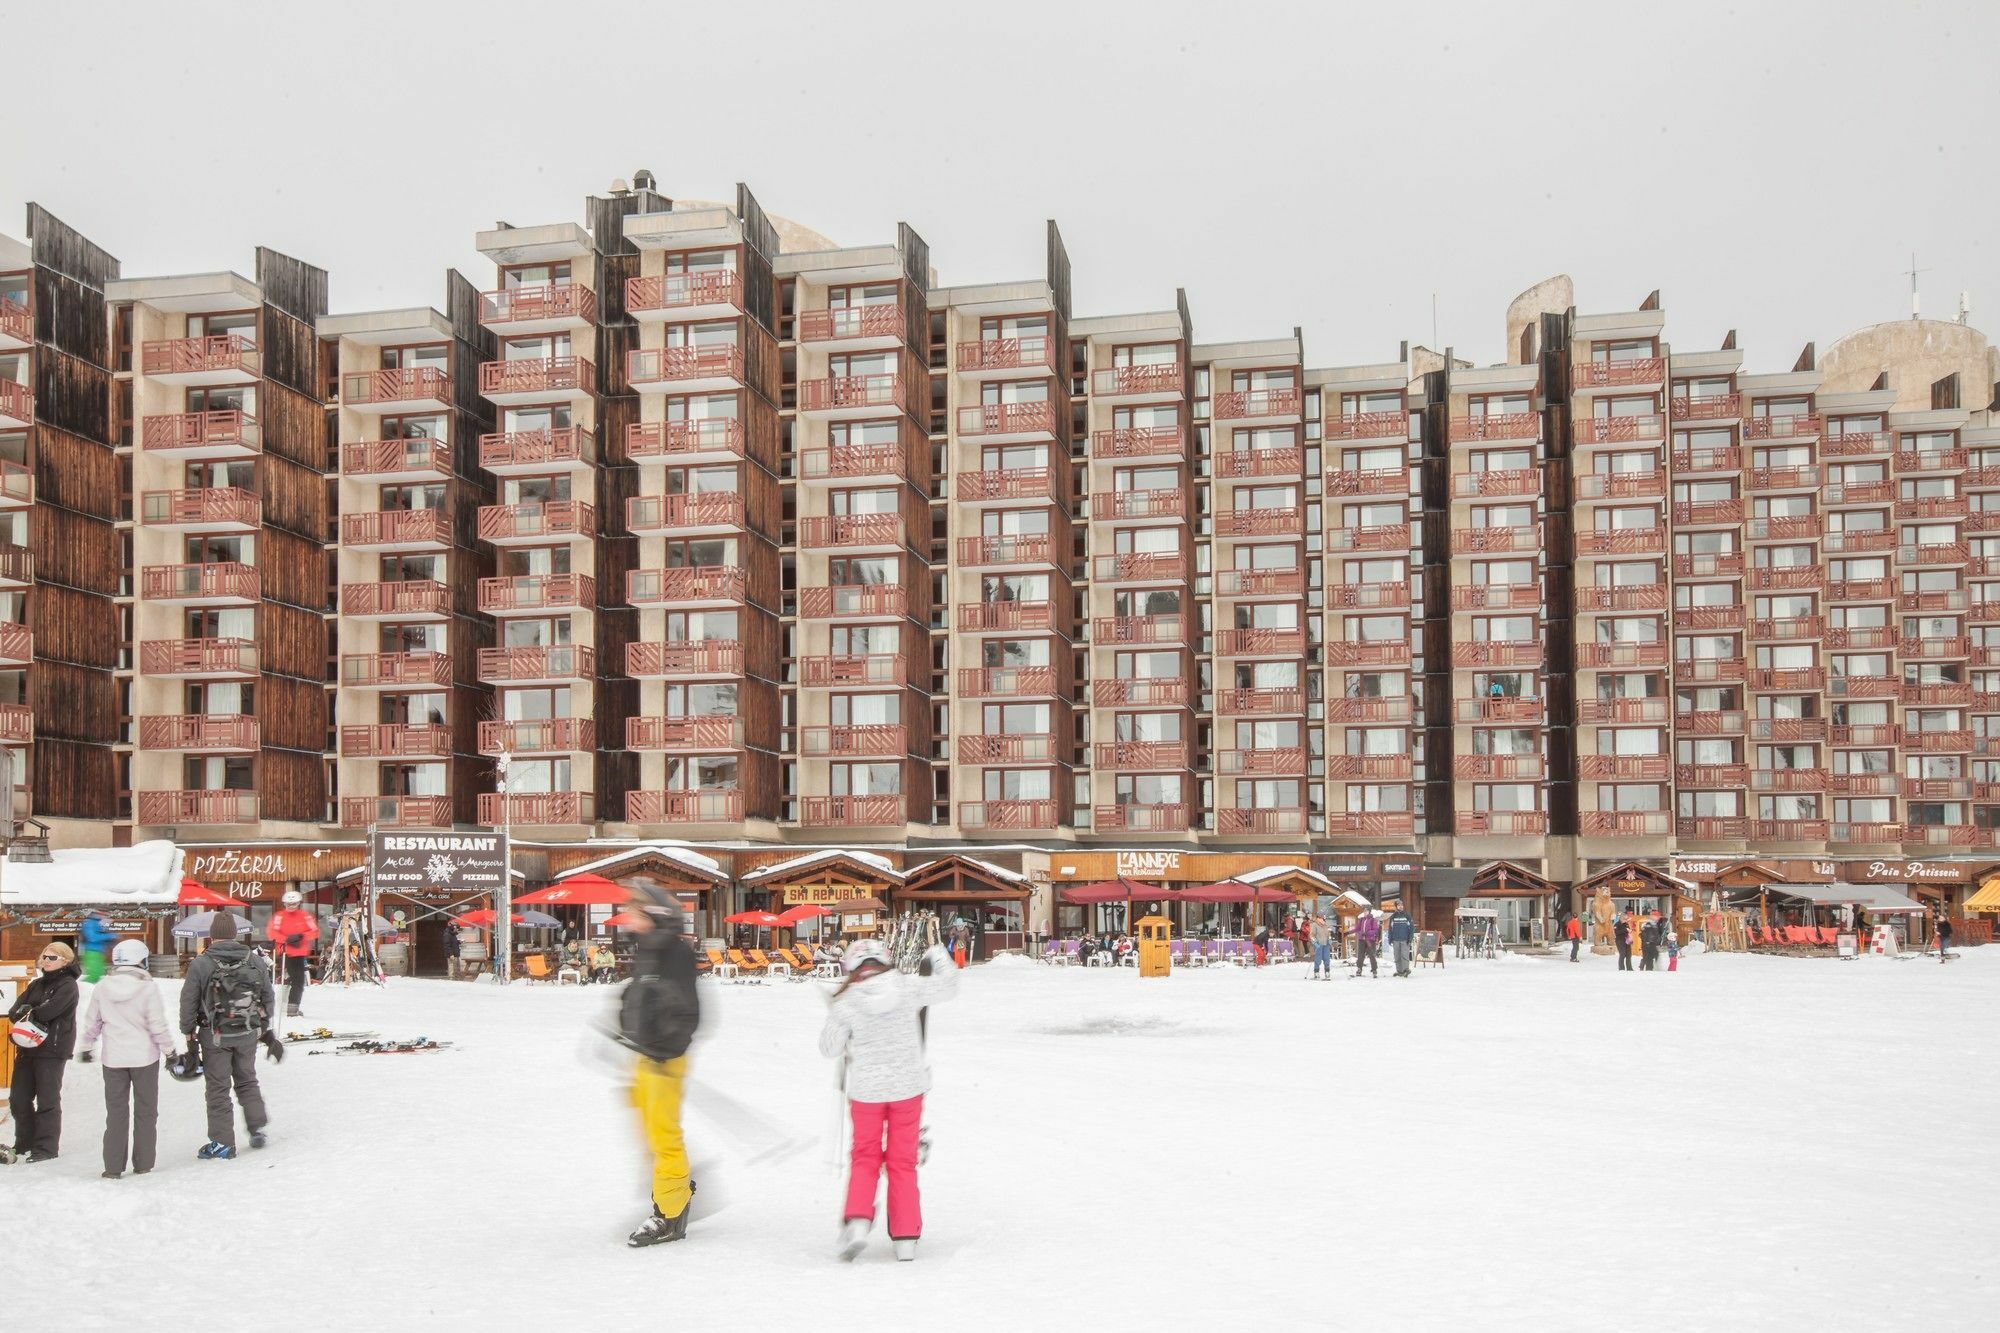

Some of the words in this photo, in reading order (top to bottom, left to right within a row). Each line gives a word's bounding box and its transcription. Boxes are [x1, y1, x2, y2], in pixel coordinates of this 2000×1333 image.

[384, 837, 497, 850] RESTAURANT
[194, 855, 286, 874] PIZZERIA
[456, 857, 464, 867] La
[1117, 852, 1179, 868] L'ANNEXE
[1117, 867, 1132, 875] Bar
[1867, 862, 1899, 878] Pain
[1904, 862, 1959, 878] Patisserie
[229, 881, 263, 899] PUB
[790, 889, 808, 900] SKI
